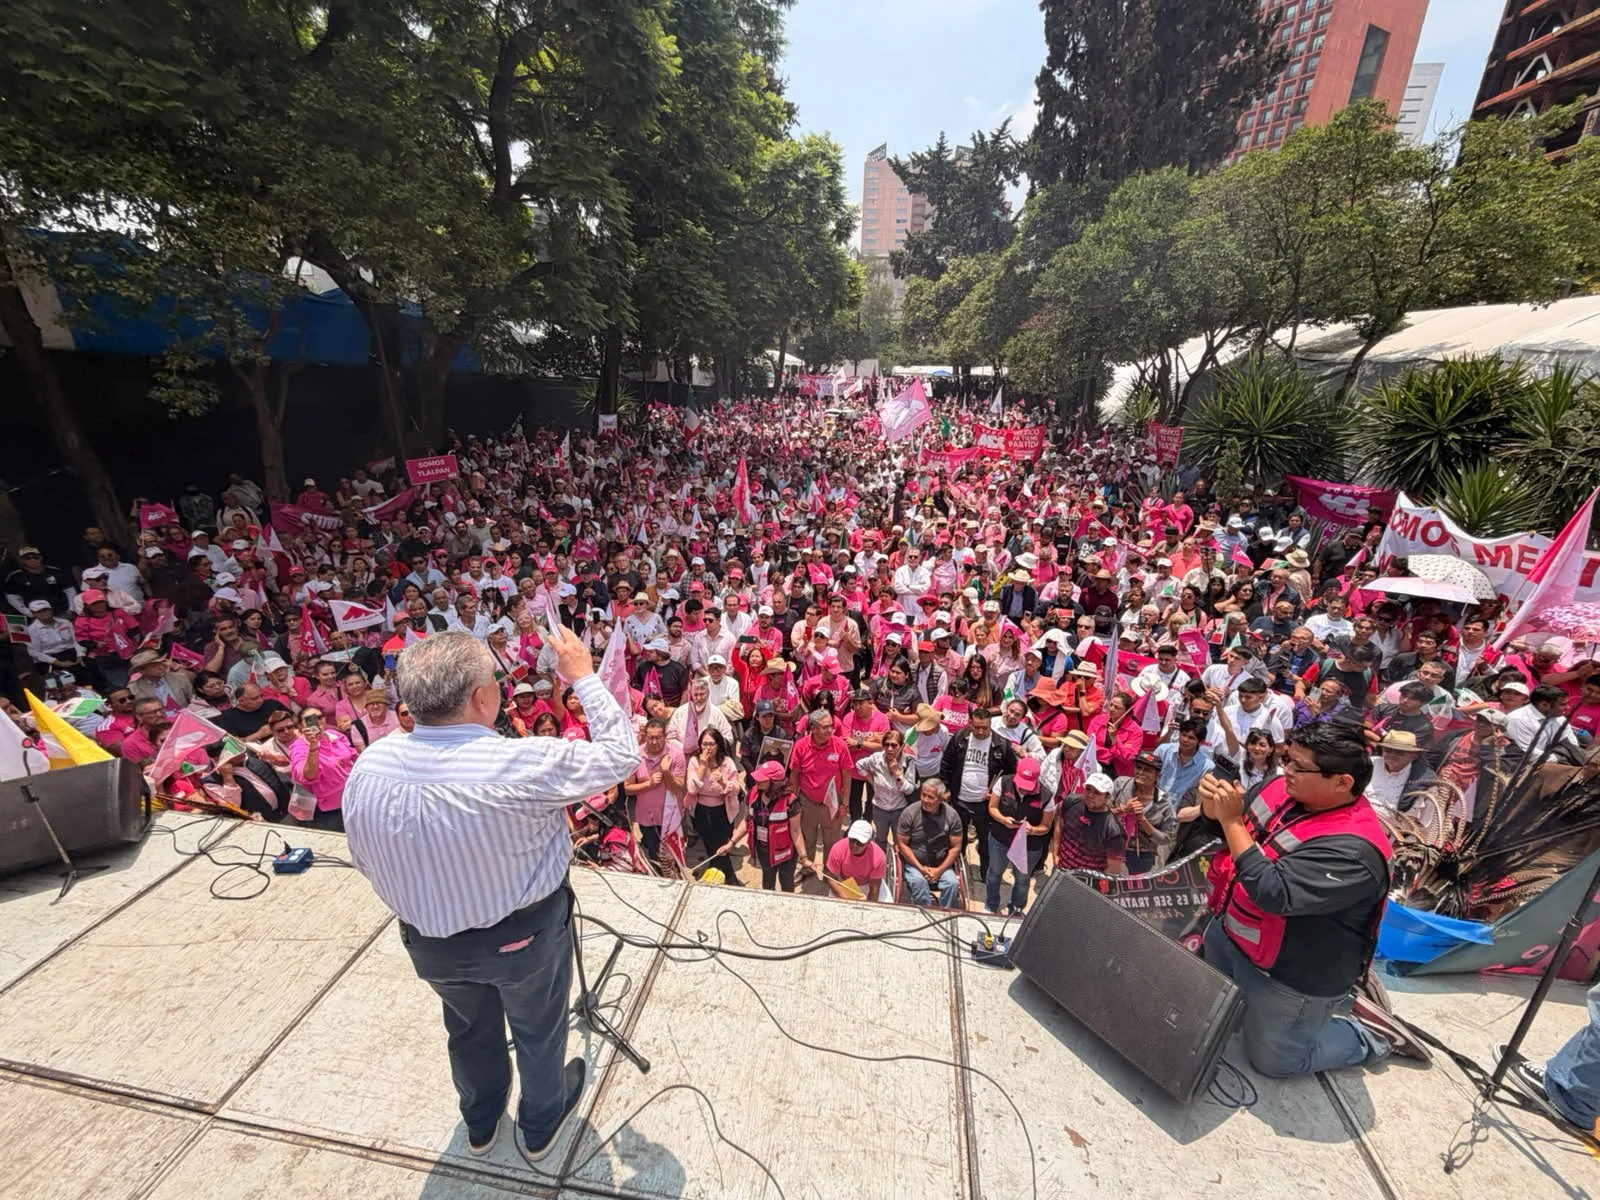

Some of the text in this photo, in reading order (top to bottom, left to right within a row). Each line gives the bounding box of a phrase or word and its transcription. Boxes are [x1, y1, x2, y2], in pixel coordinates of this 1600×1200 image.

[418, 459, 445, 468] SOMOS
[417, 467, 450, 477] TLALPAN
[1325, 486, 1371, 497] SOMOS
